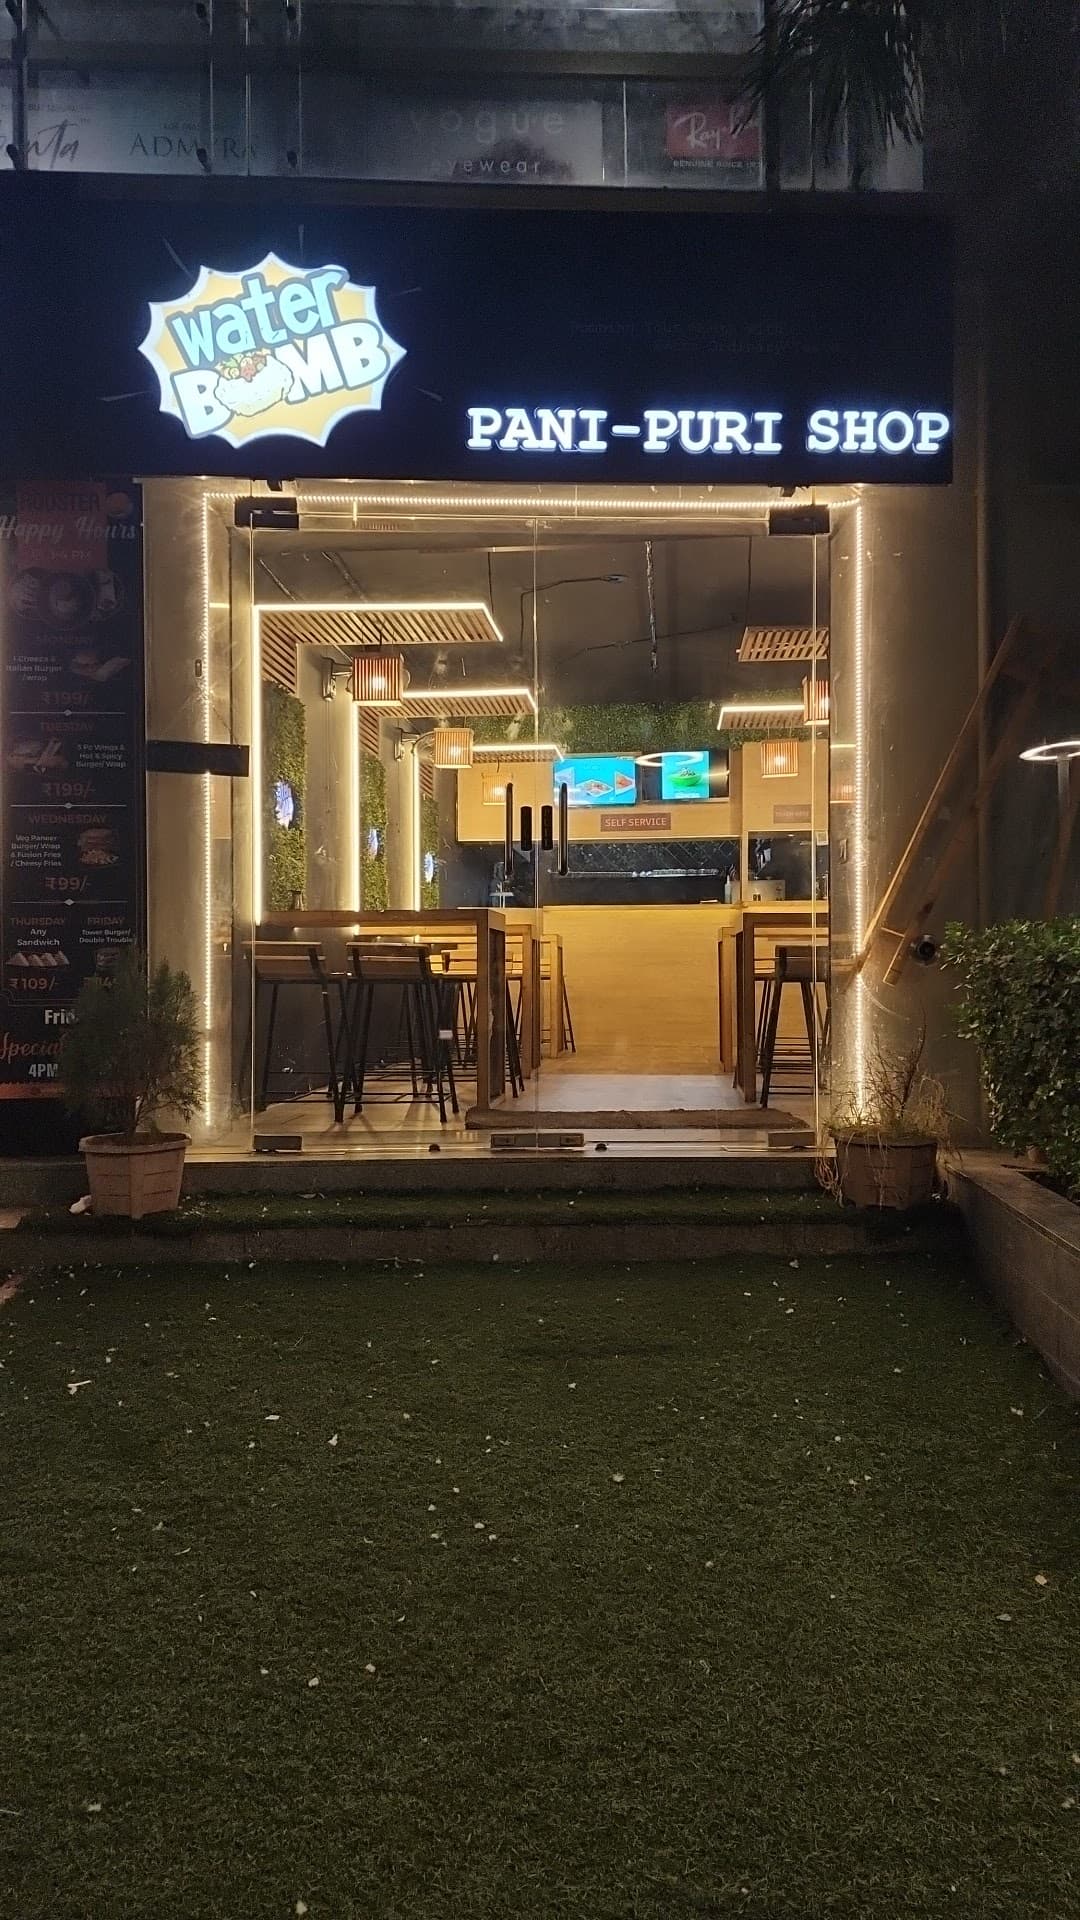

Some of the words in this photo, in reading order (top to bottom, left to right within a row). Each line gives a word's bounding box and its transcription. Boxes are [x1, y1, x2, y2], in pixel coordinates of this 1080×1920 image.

[411, 110, 561, 144] ogue
[431, 160, 541, 176] yewear
[166, 268, 349, 370] water
[466, 406, 782, 454] PANI-PURI
[806, 408, 951, 454] SHOP
[29, 815, 106, 824] WEDNESDAY
[605, 818, 627, 827] SELF
[628, 817, 667, 827] SERVICE
[10, 917, 66, 925] THURSDAY
[87, 917, 126, 925] FRIDAY
[30, 928, 47, 936] Any
[17, 938, 60, 946] Sandwich
